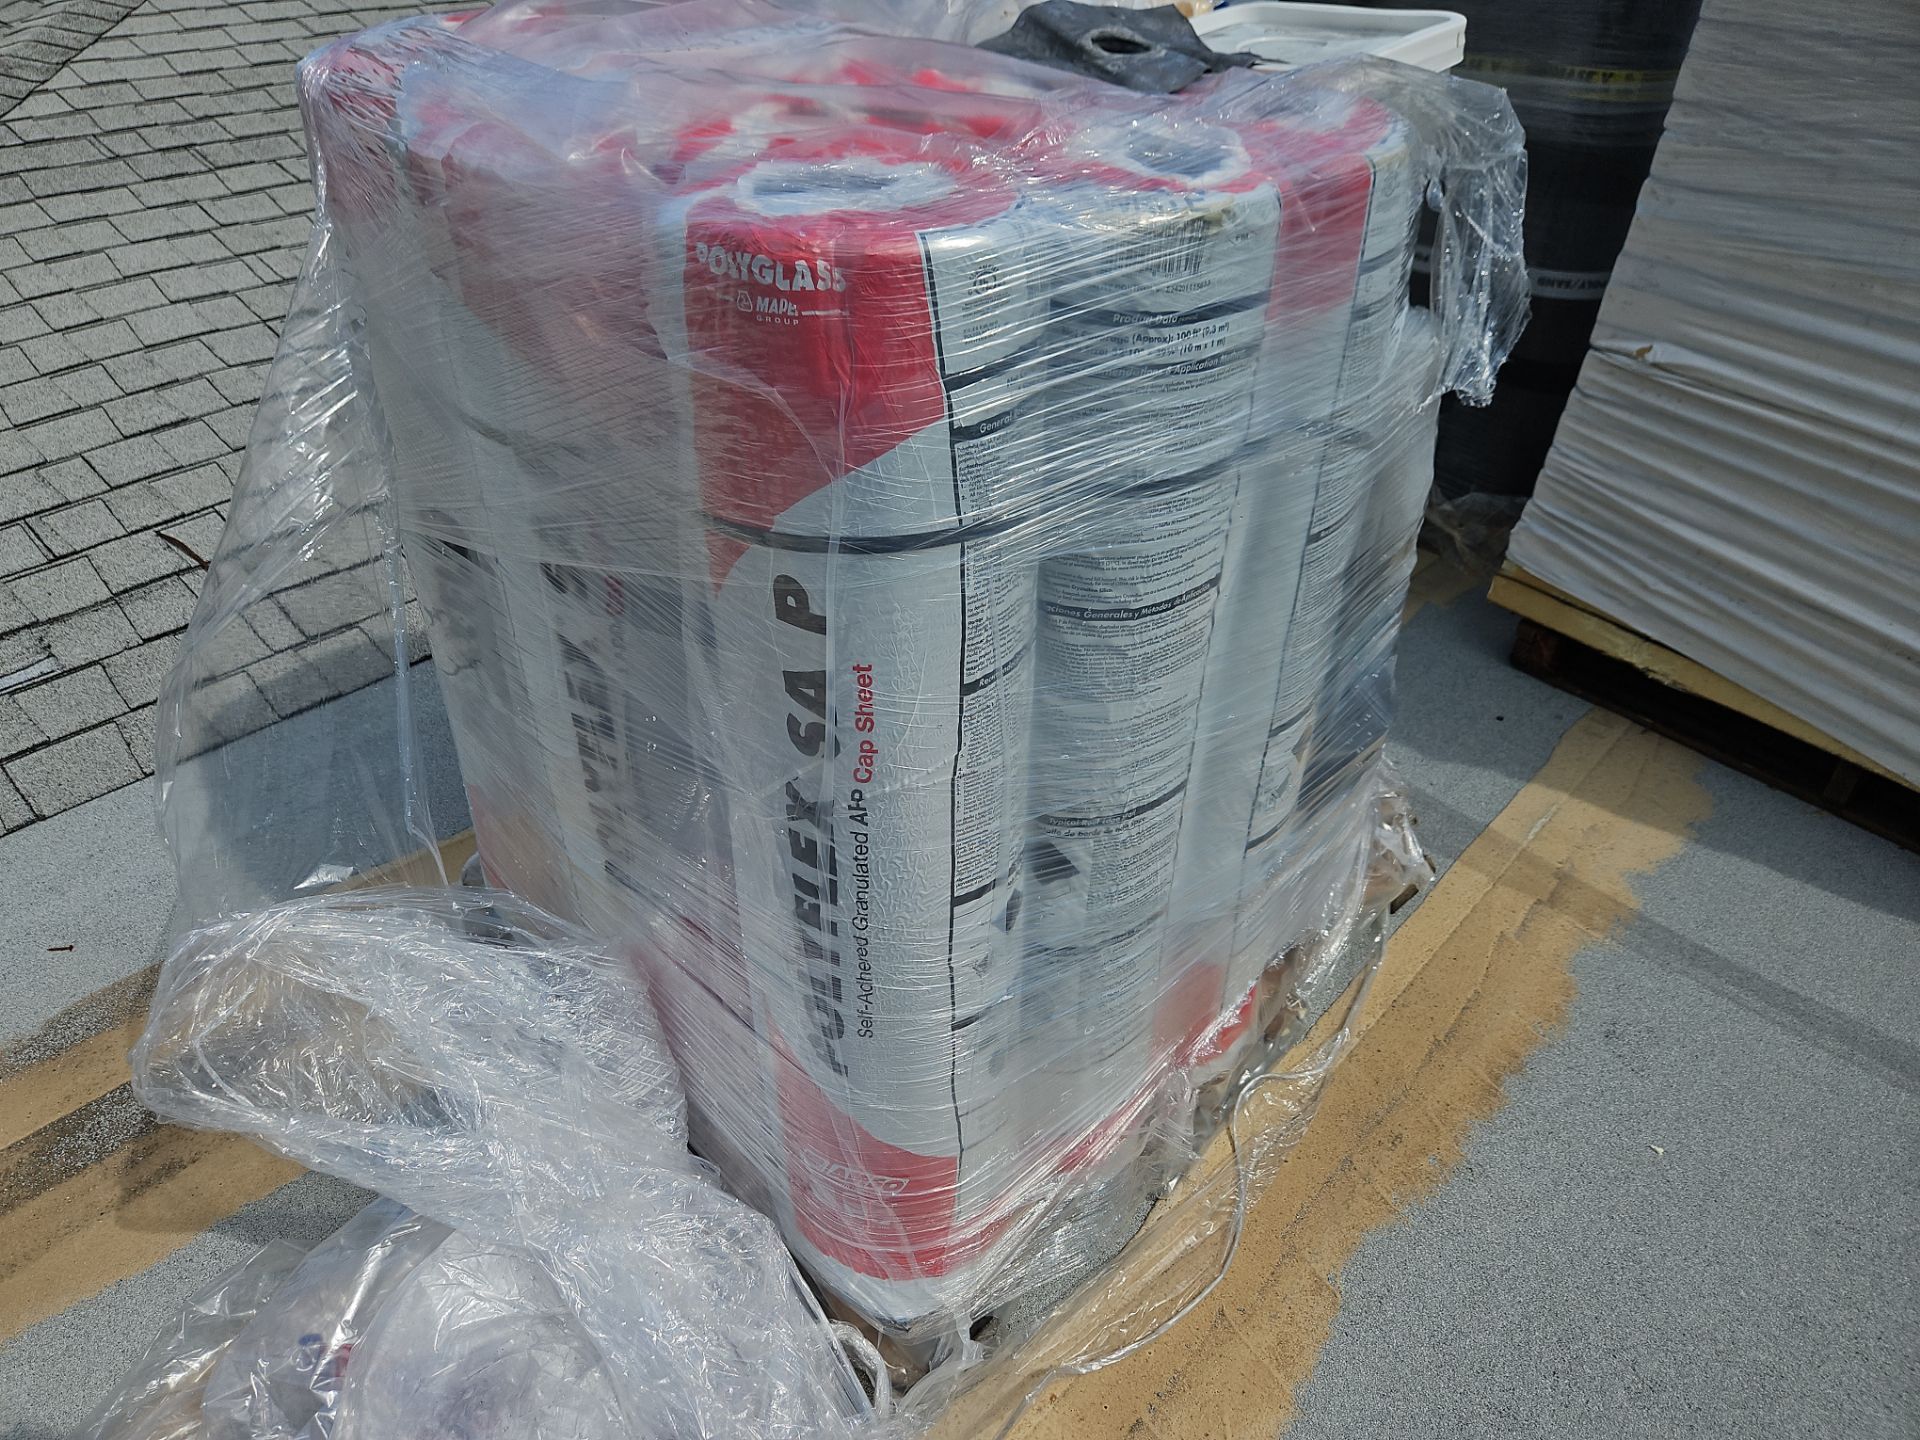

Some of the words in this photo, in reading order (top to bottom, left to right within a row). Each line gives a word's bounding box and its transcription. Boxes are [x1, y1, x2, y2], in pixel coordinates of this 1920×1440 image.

[695, 241, 848, 293] POLYGLASS
[756, 316, 799, 325] GROUP
[1132, 332, 1174, 345] (Approx):
[1083, 609, 1132, 620] Generales
[852, 663, 876, 734] Sheet
[852, 739, 879, 784] Cap
[849, 831, 871, 931] Granulated
